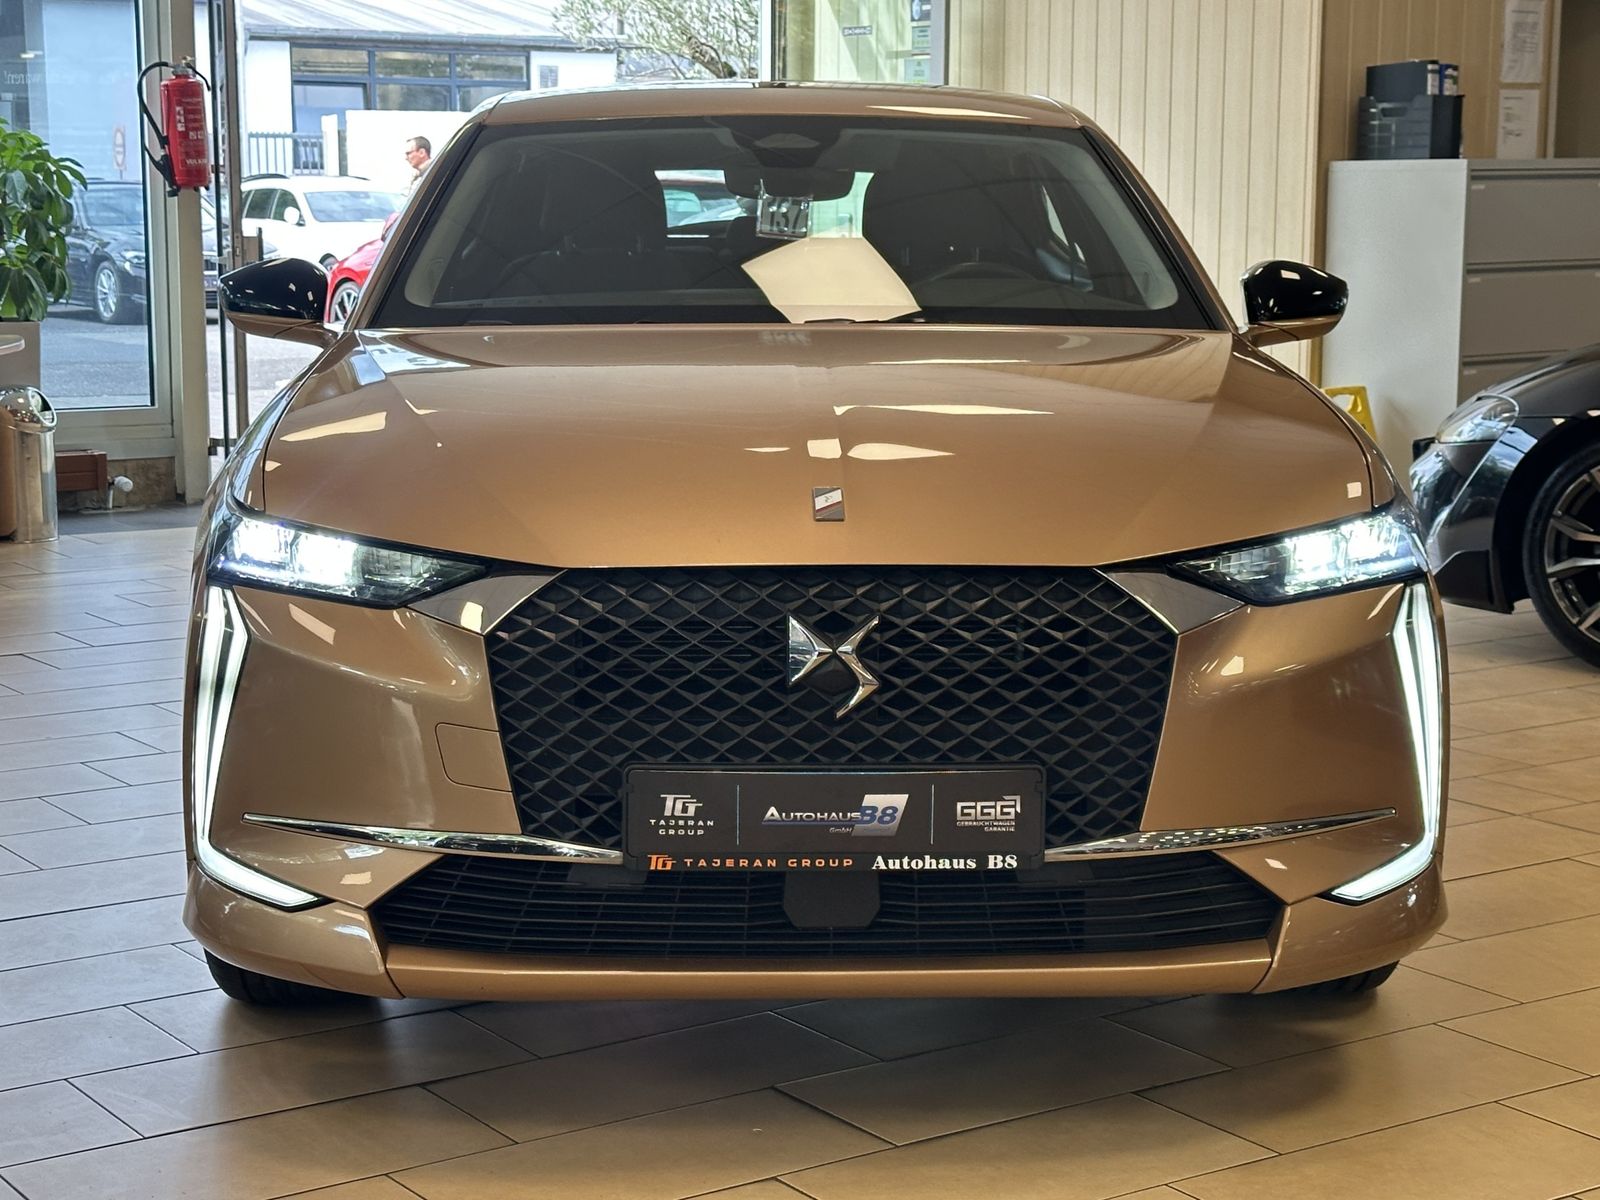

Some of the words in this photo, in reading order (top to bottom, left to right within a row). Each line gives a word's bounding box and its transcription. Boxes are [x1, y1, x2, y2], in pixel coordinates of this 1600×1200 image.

[956, 800, 1016, 820] GGG
[684, 858, 777, 868] TAJERAN
[787, 858, 854, 868] GROUP
[871, 854, 977, 870] Autohaus
[986, 854, 1018, 870] B8
